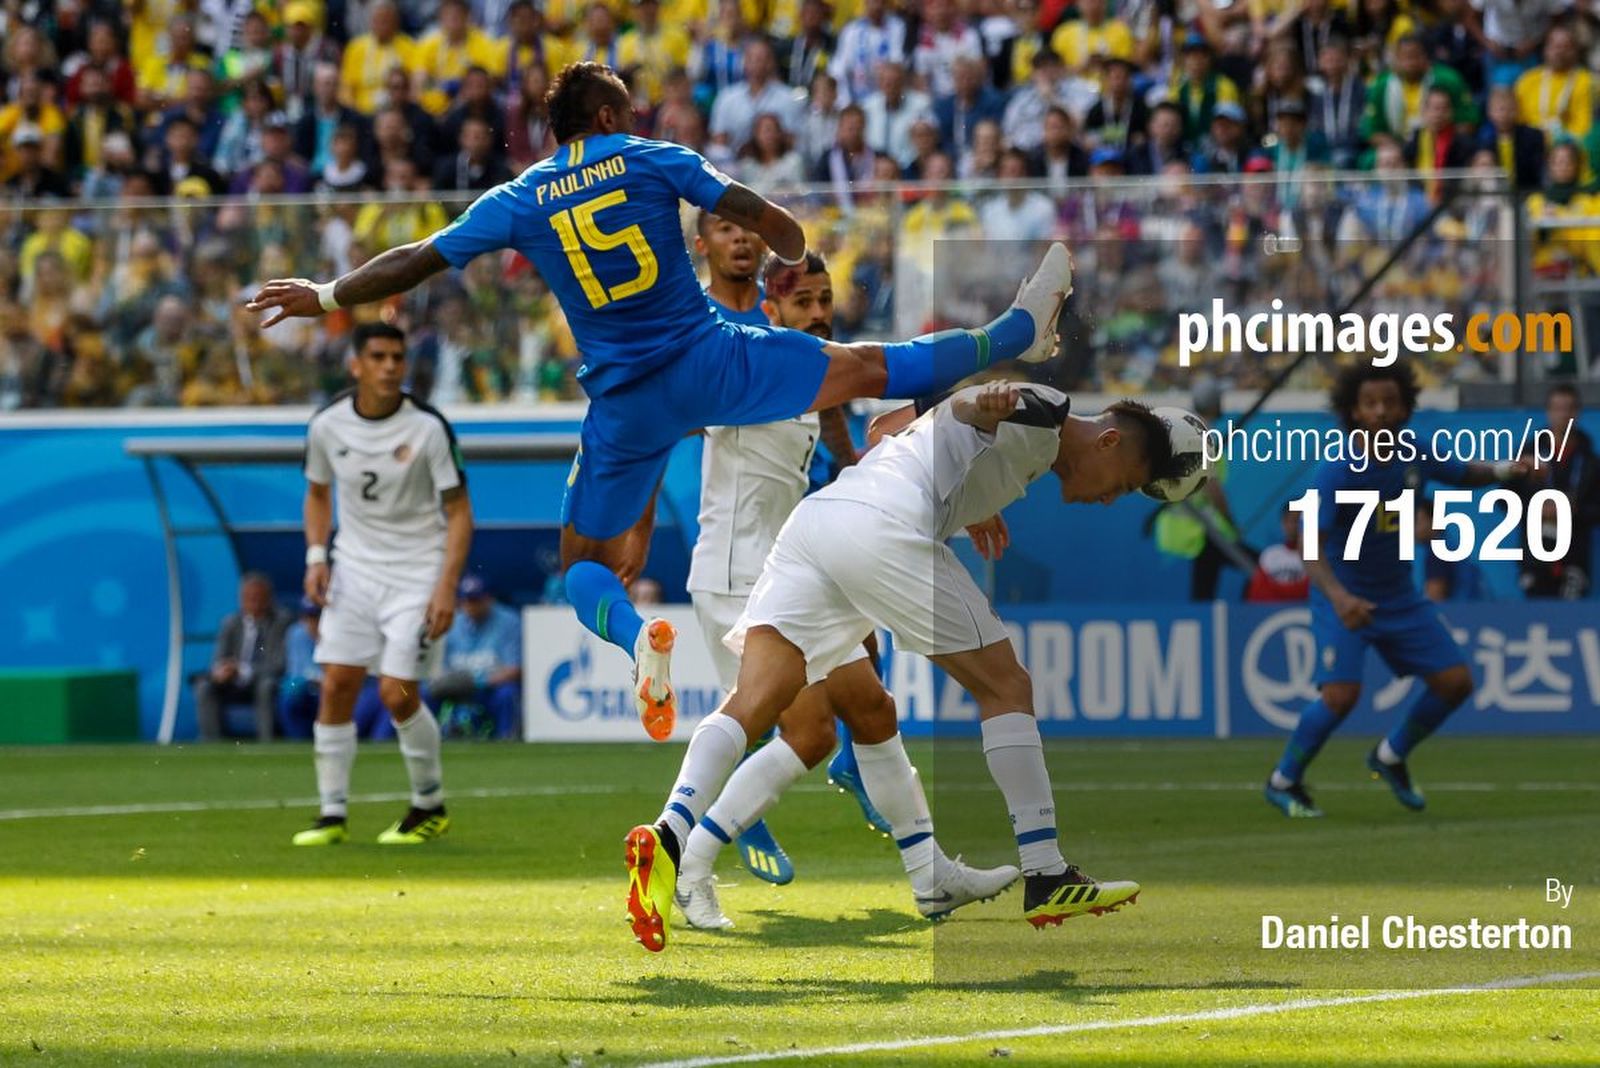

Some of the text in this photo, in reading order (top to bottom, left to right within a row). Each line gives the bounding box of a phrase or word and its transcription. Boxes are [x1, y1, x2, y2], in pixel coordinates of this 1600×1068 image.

[536, 155, 626, 205] PAULINHO
[549, 189, 658, 309] 15
[360, 470, 380, 502] 2
